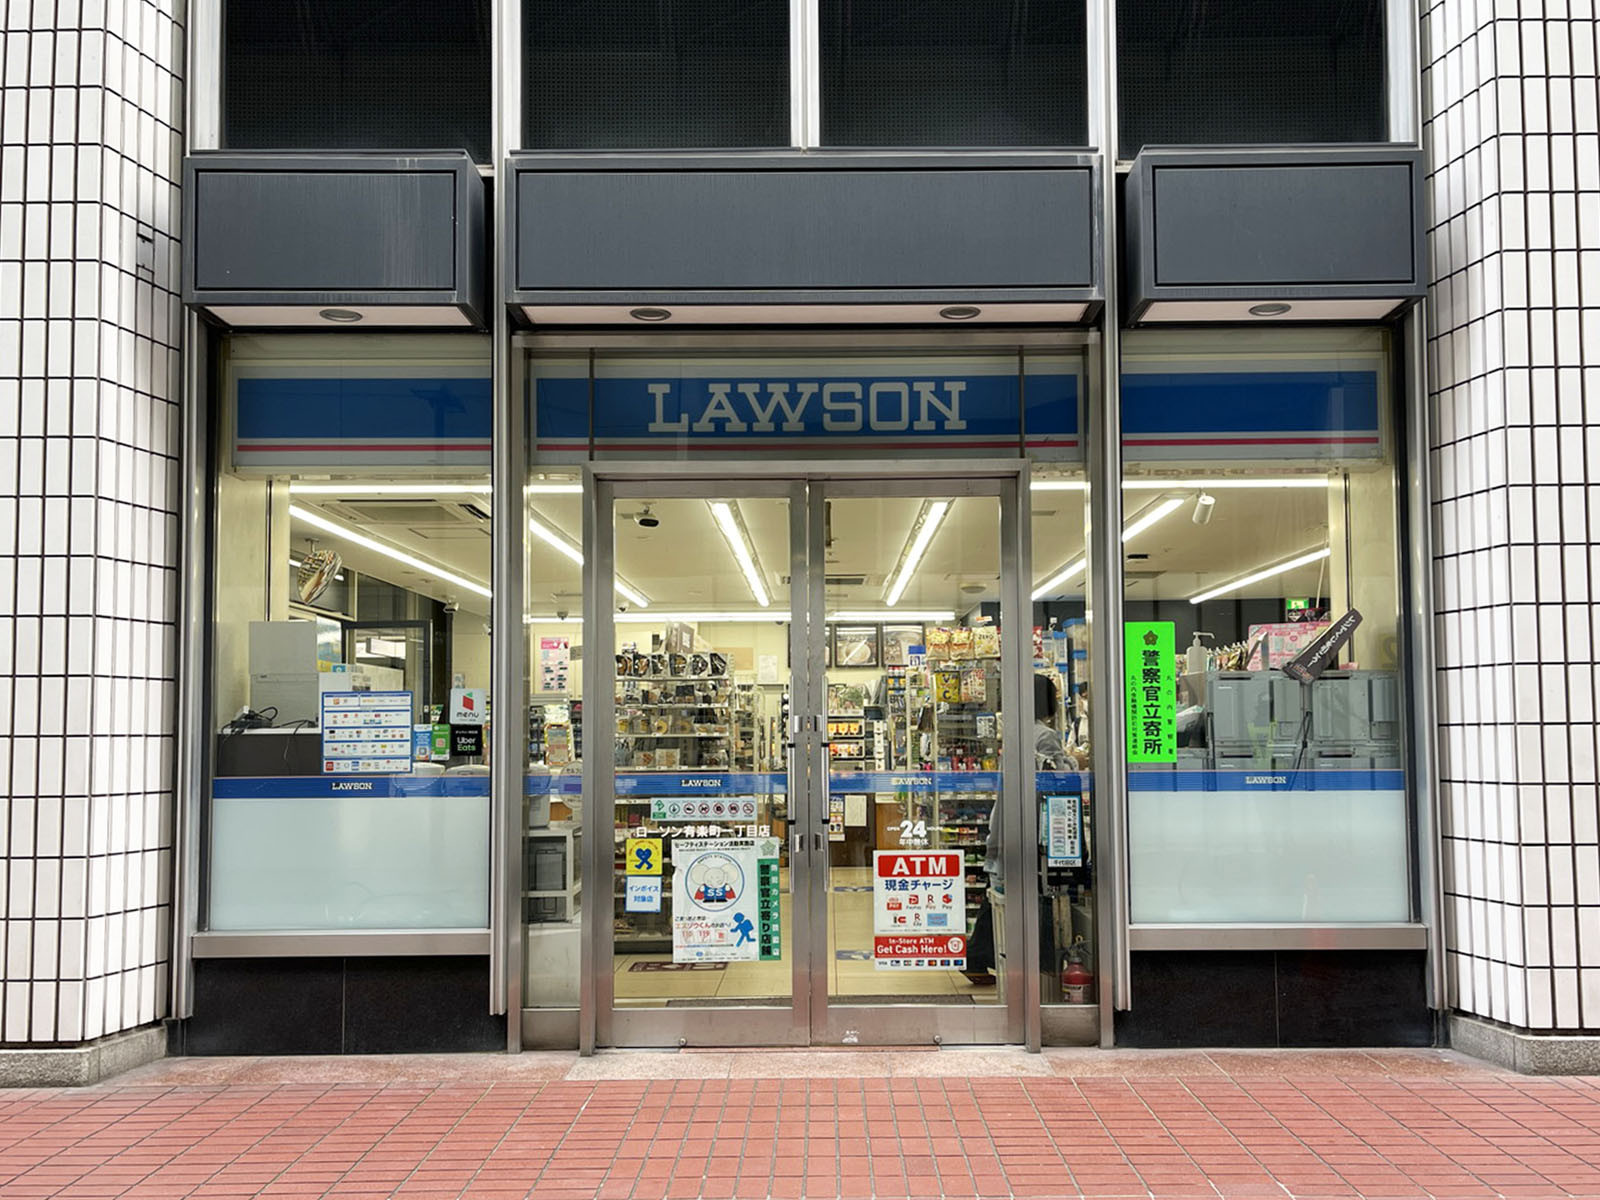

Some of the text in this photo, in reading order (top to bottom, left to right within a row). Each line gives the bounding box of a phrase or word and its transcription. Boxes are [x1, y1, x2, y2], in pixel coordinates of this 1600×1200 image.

[647, 381, 967, 432] LAWSON
[1141, 650, 1162, 755] 警察官立寄所
[457, 736, 476, 744] Uber
[681, 779, 721, 787] LAWSON
[891, 777, 932, 785] LAWSON
[1245, 776, 1286, 784] LAWSON
[331, 782, 373, 790] LAWSON
[636, 825, 770, 838] ローソン有楽町一丁目店
[900, 820, 927, 838] 24
[891, 857, 947, 875] ATM
[885, 879, 953, 891] 現金チャージ
[877, 945, 947, 954] Get Cash Here!
